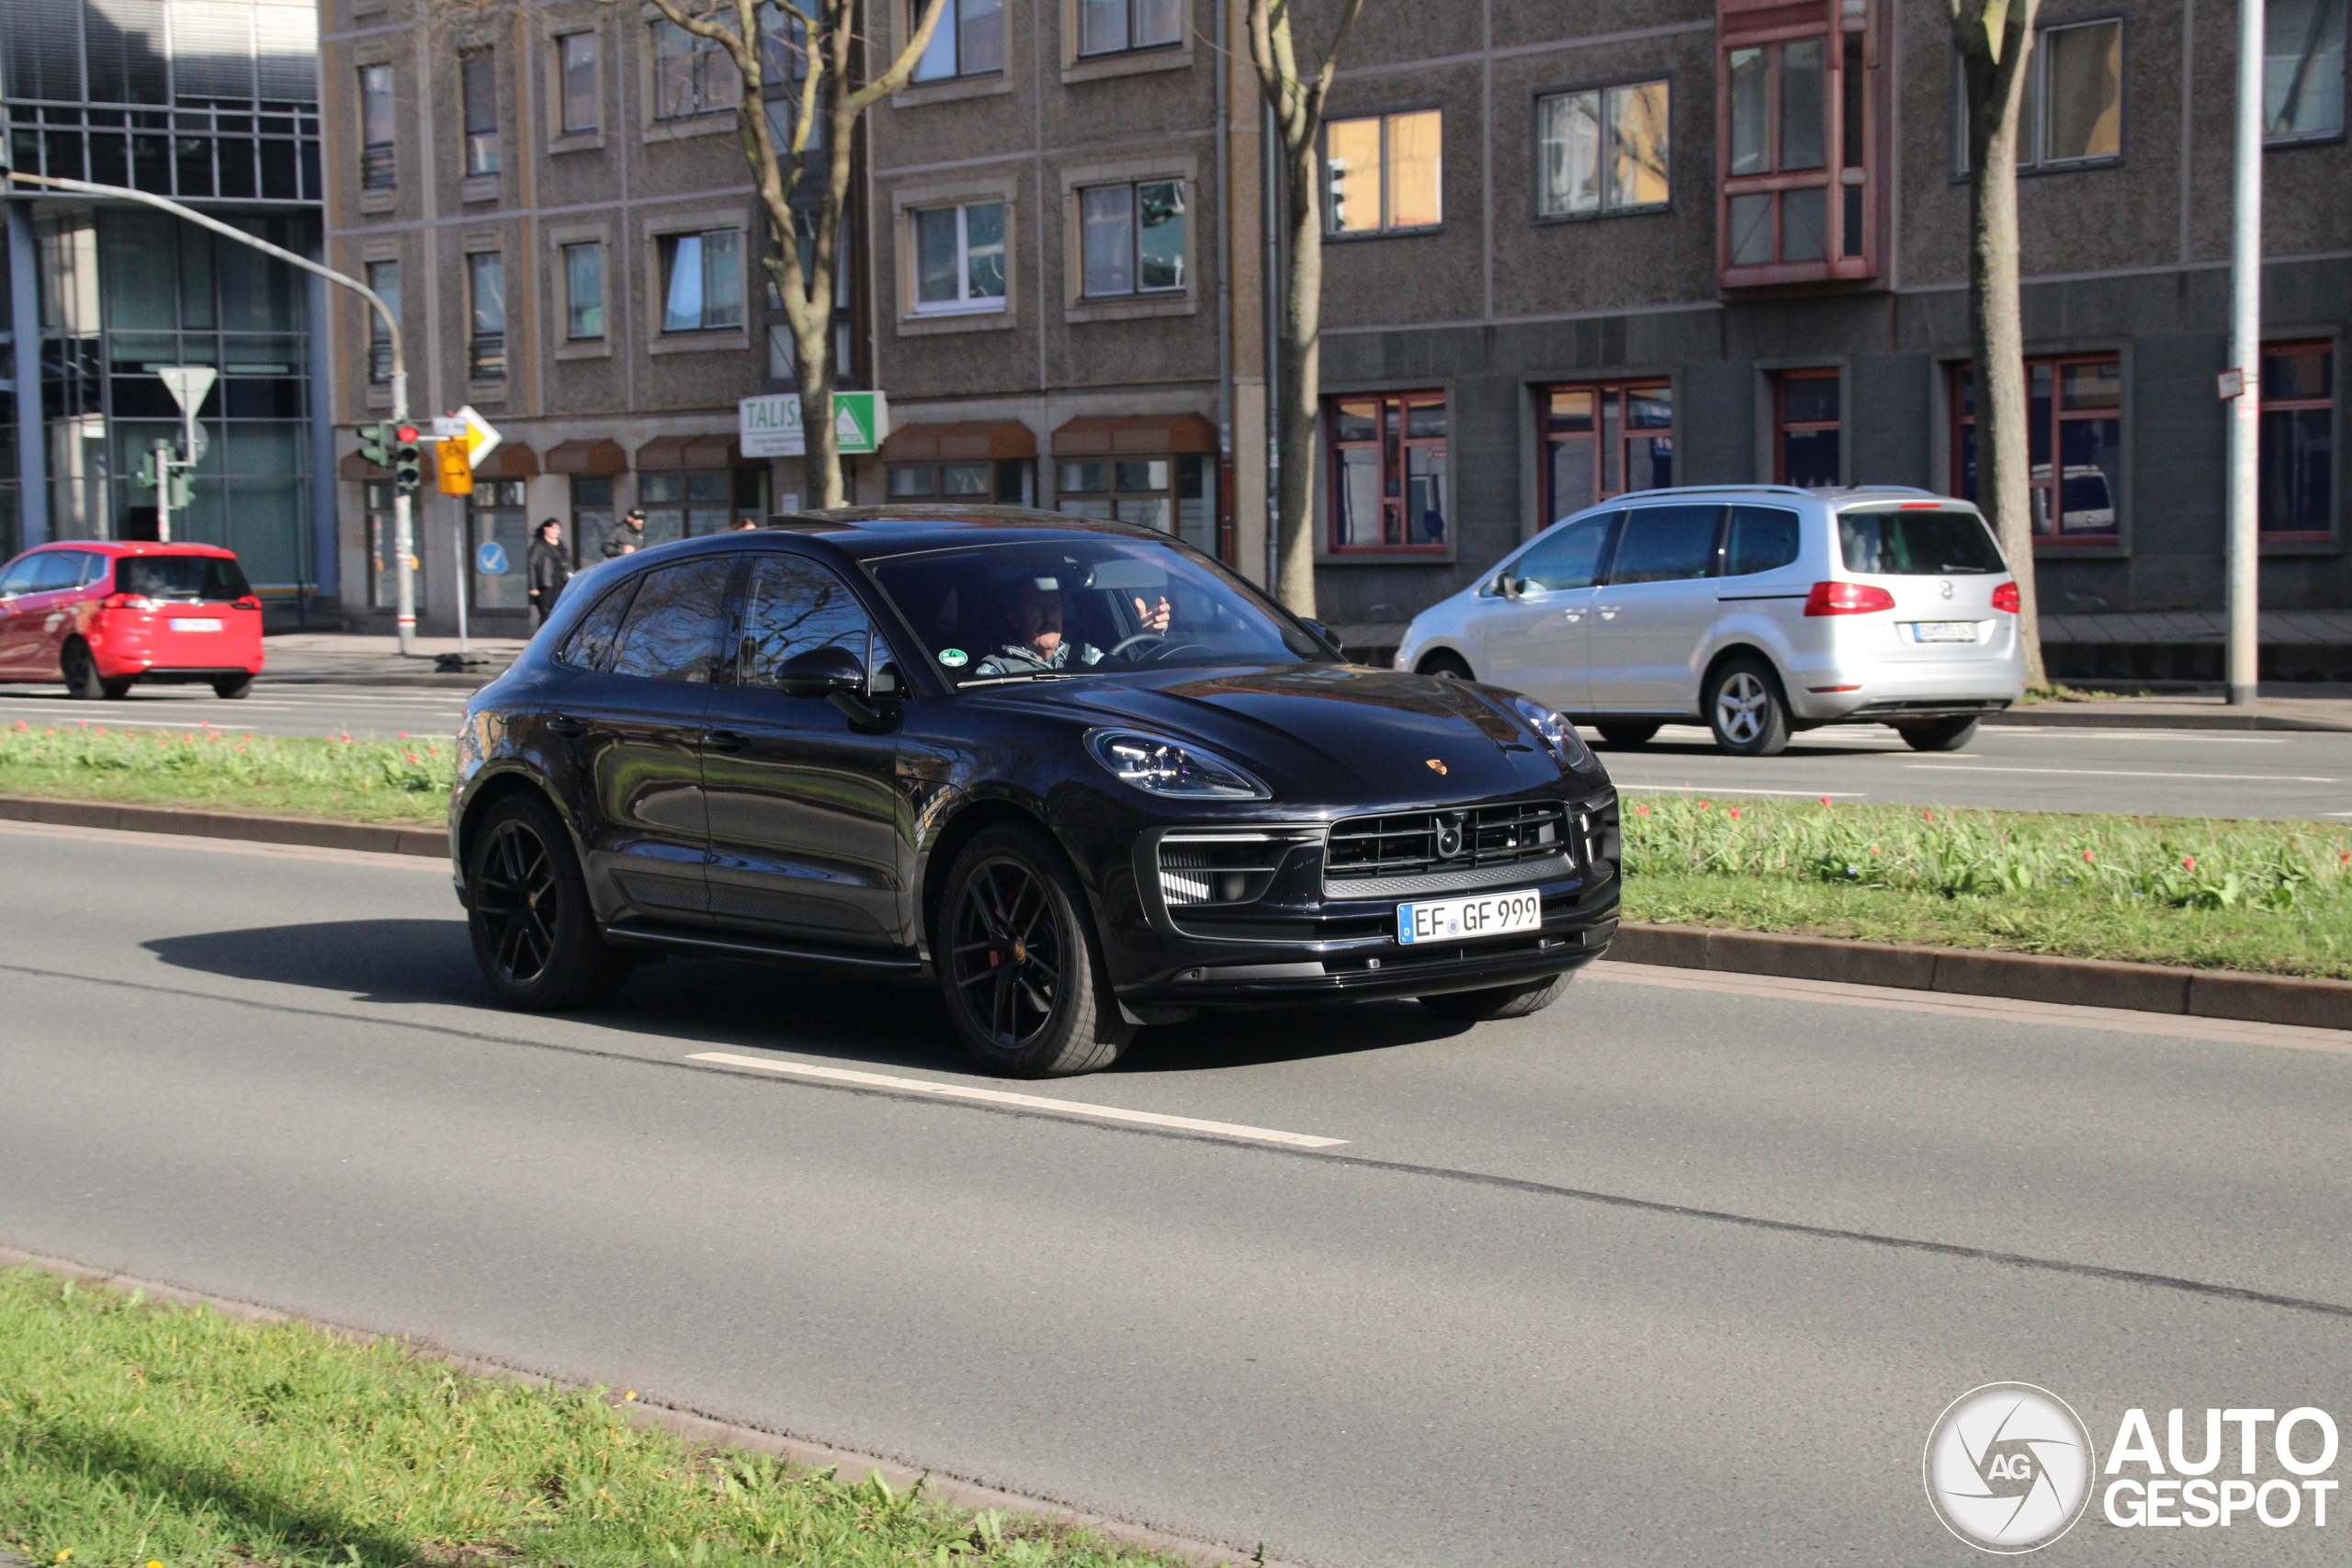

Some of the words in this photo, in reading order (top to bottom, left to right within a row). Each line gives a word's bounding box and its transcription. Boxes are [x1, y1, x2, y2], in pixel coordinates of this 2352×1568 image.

[746, 400, 804, 429] TALIS
[1404, 927, 1410, 936] D
[1415, 907, 1445, 937] EF
[1463, 901, 1492, 931] GF
[1498, 897, 1537, 928] 999
